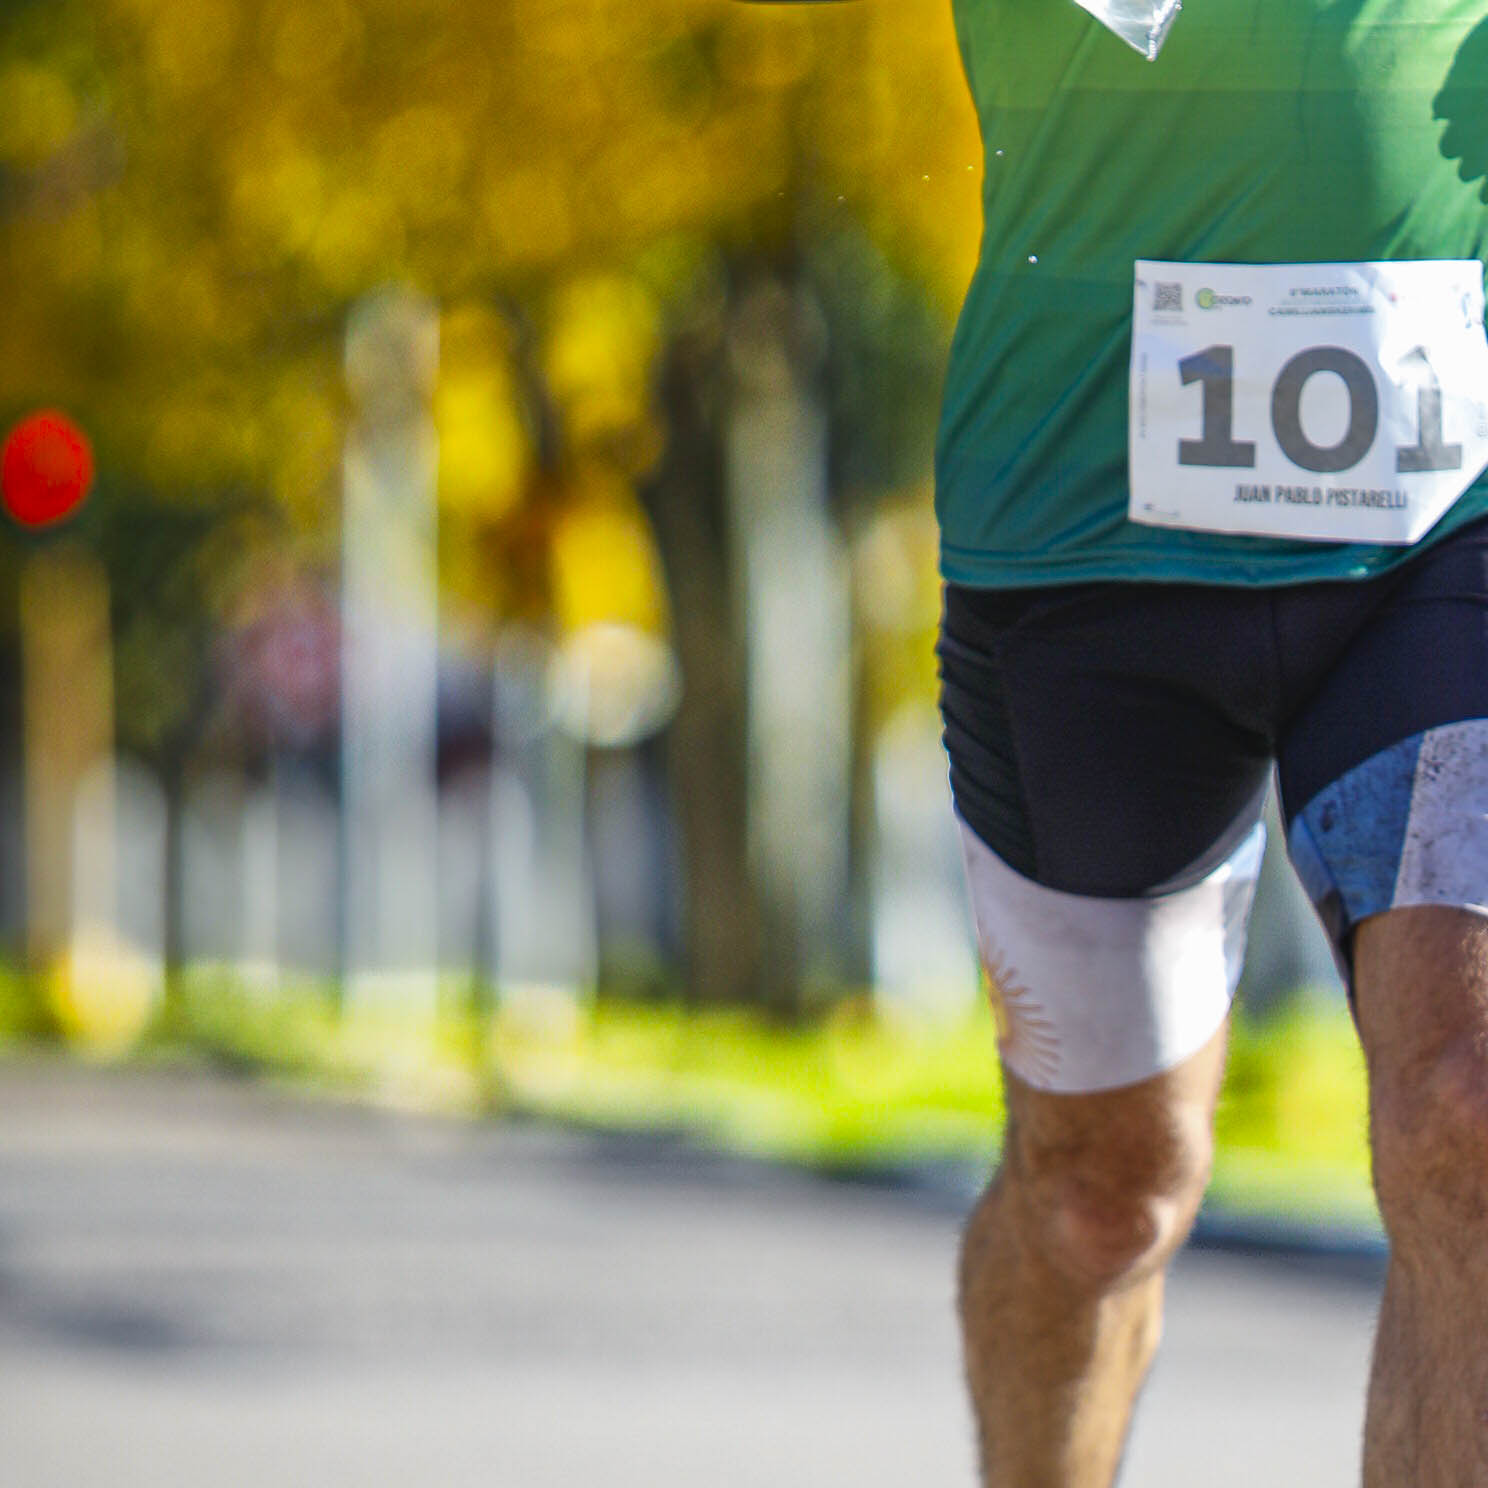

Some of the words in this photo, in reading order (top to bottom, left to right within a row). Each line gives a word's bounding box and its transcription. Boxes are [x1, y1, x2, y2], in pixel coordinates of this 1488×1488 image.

[1177, 344, 1463, 474] 101
[1233, 484, 1271, 503] JUAN
[1275, 485, 1322, 506] PABLO
[1326, 487, 1408, 509] PISTARELLI
